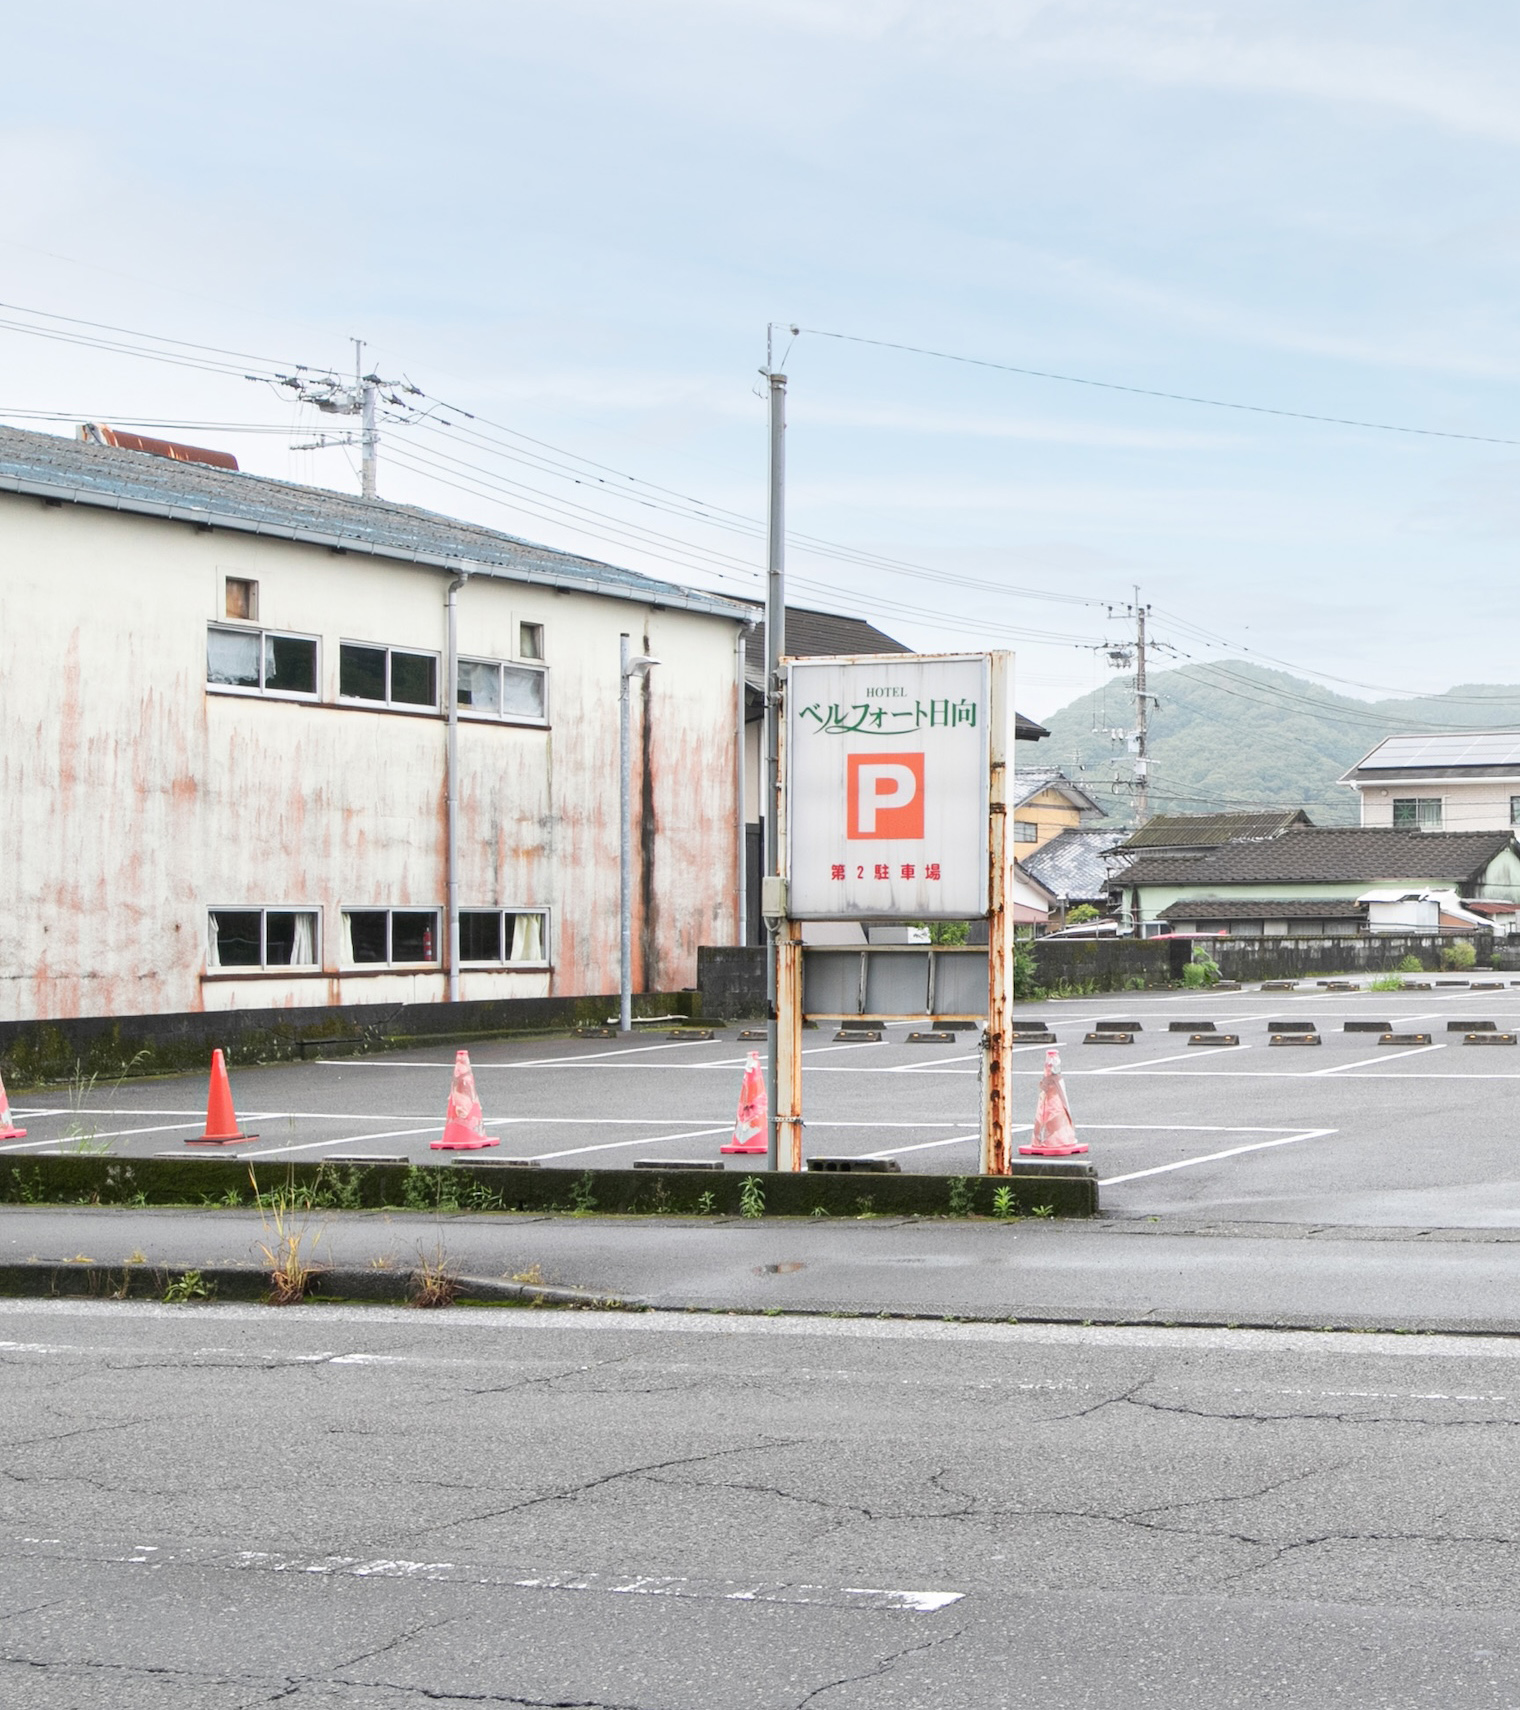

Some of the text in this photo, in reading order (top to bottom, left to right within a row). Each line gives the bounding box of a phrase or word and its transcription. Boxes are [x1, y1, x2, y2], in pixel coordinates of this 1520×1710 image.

[866, 687, 907, 698] HOTEL
[799, 699, 977, 735] ベルフォート日向
[858, 764, 916, 833] P
[831, 863, 941, 881] 第2駐車場
